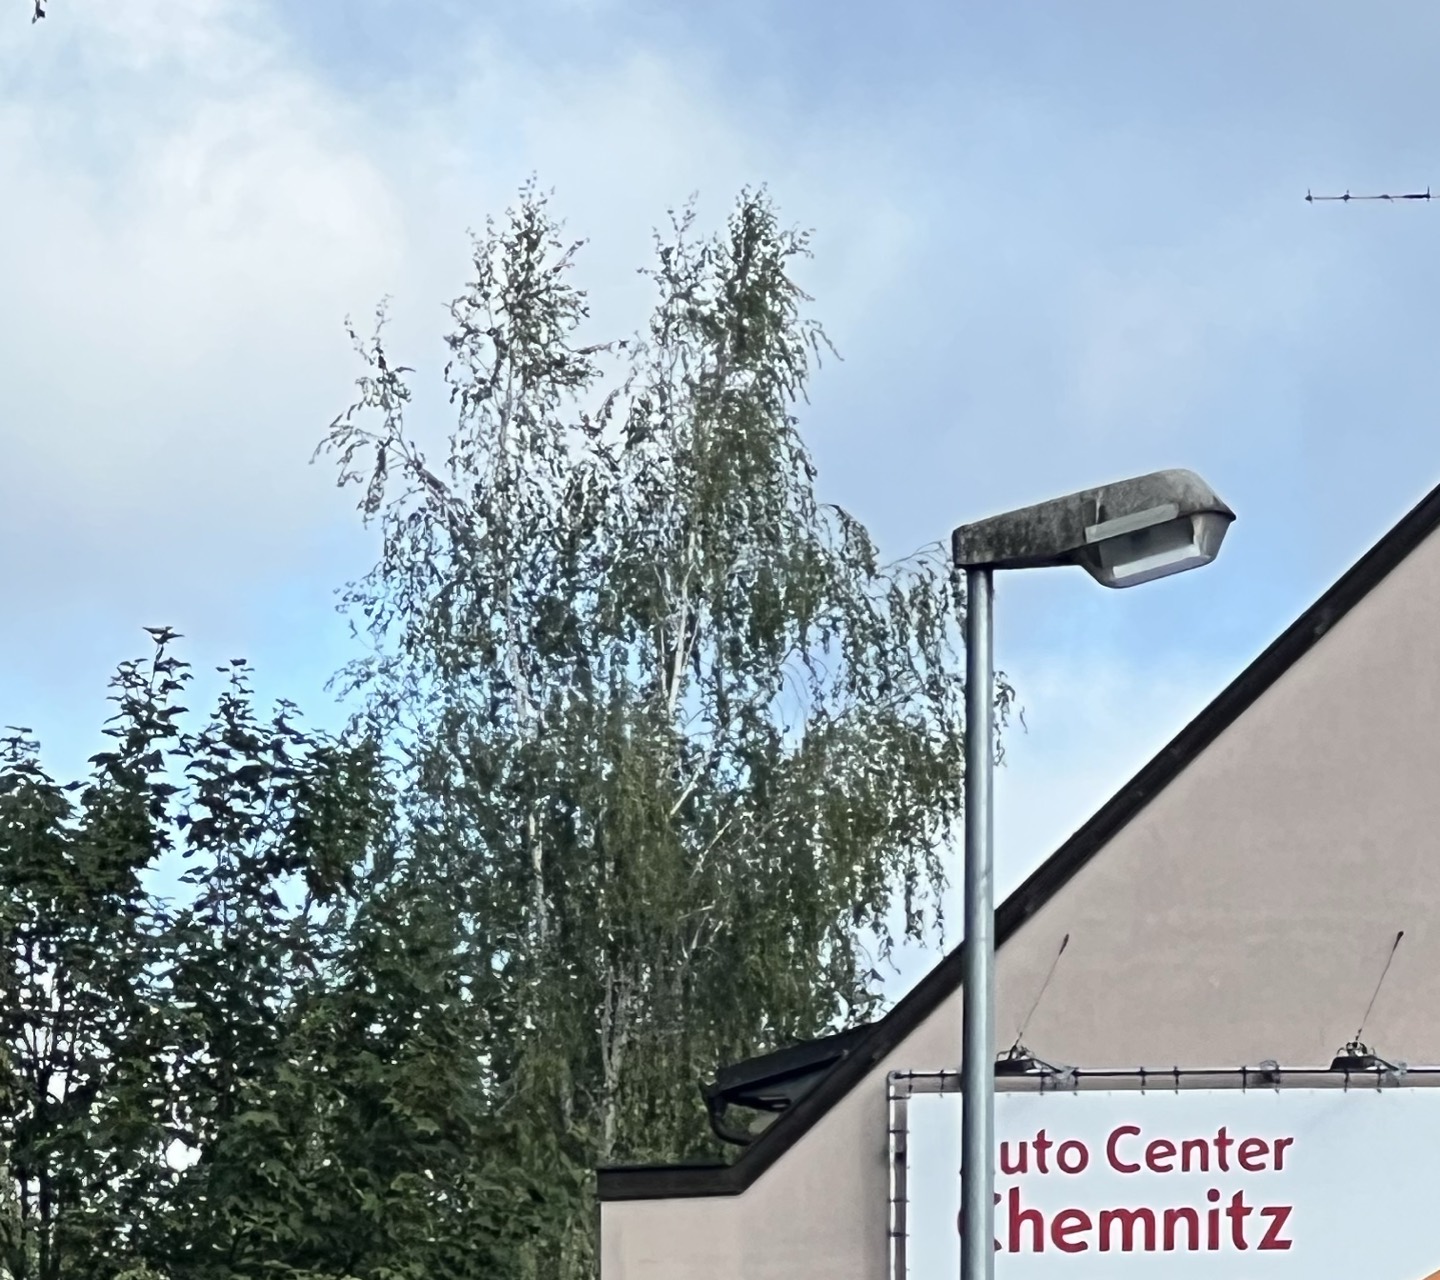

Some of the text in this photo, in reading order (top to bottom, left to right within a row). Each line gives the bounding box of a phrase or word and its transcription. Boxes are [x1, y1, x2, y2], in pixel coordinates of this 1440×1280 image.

[1000, 1126, 1293, 1175] uto Center
[957, 1187, 1293, 1253] hemnitz
